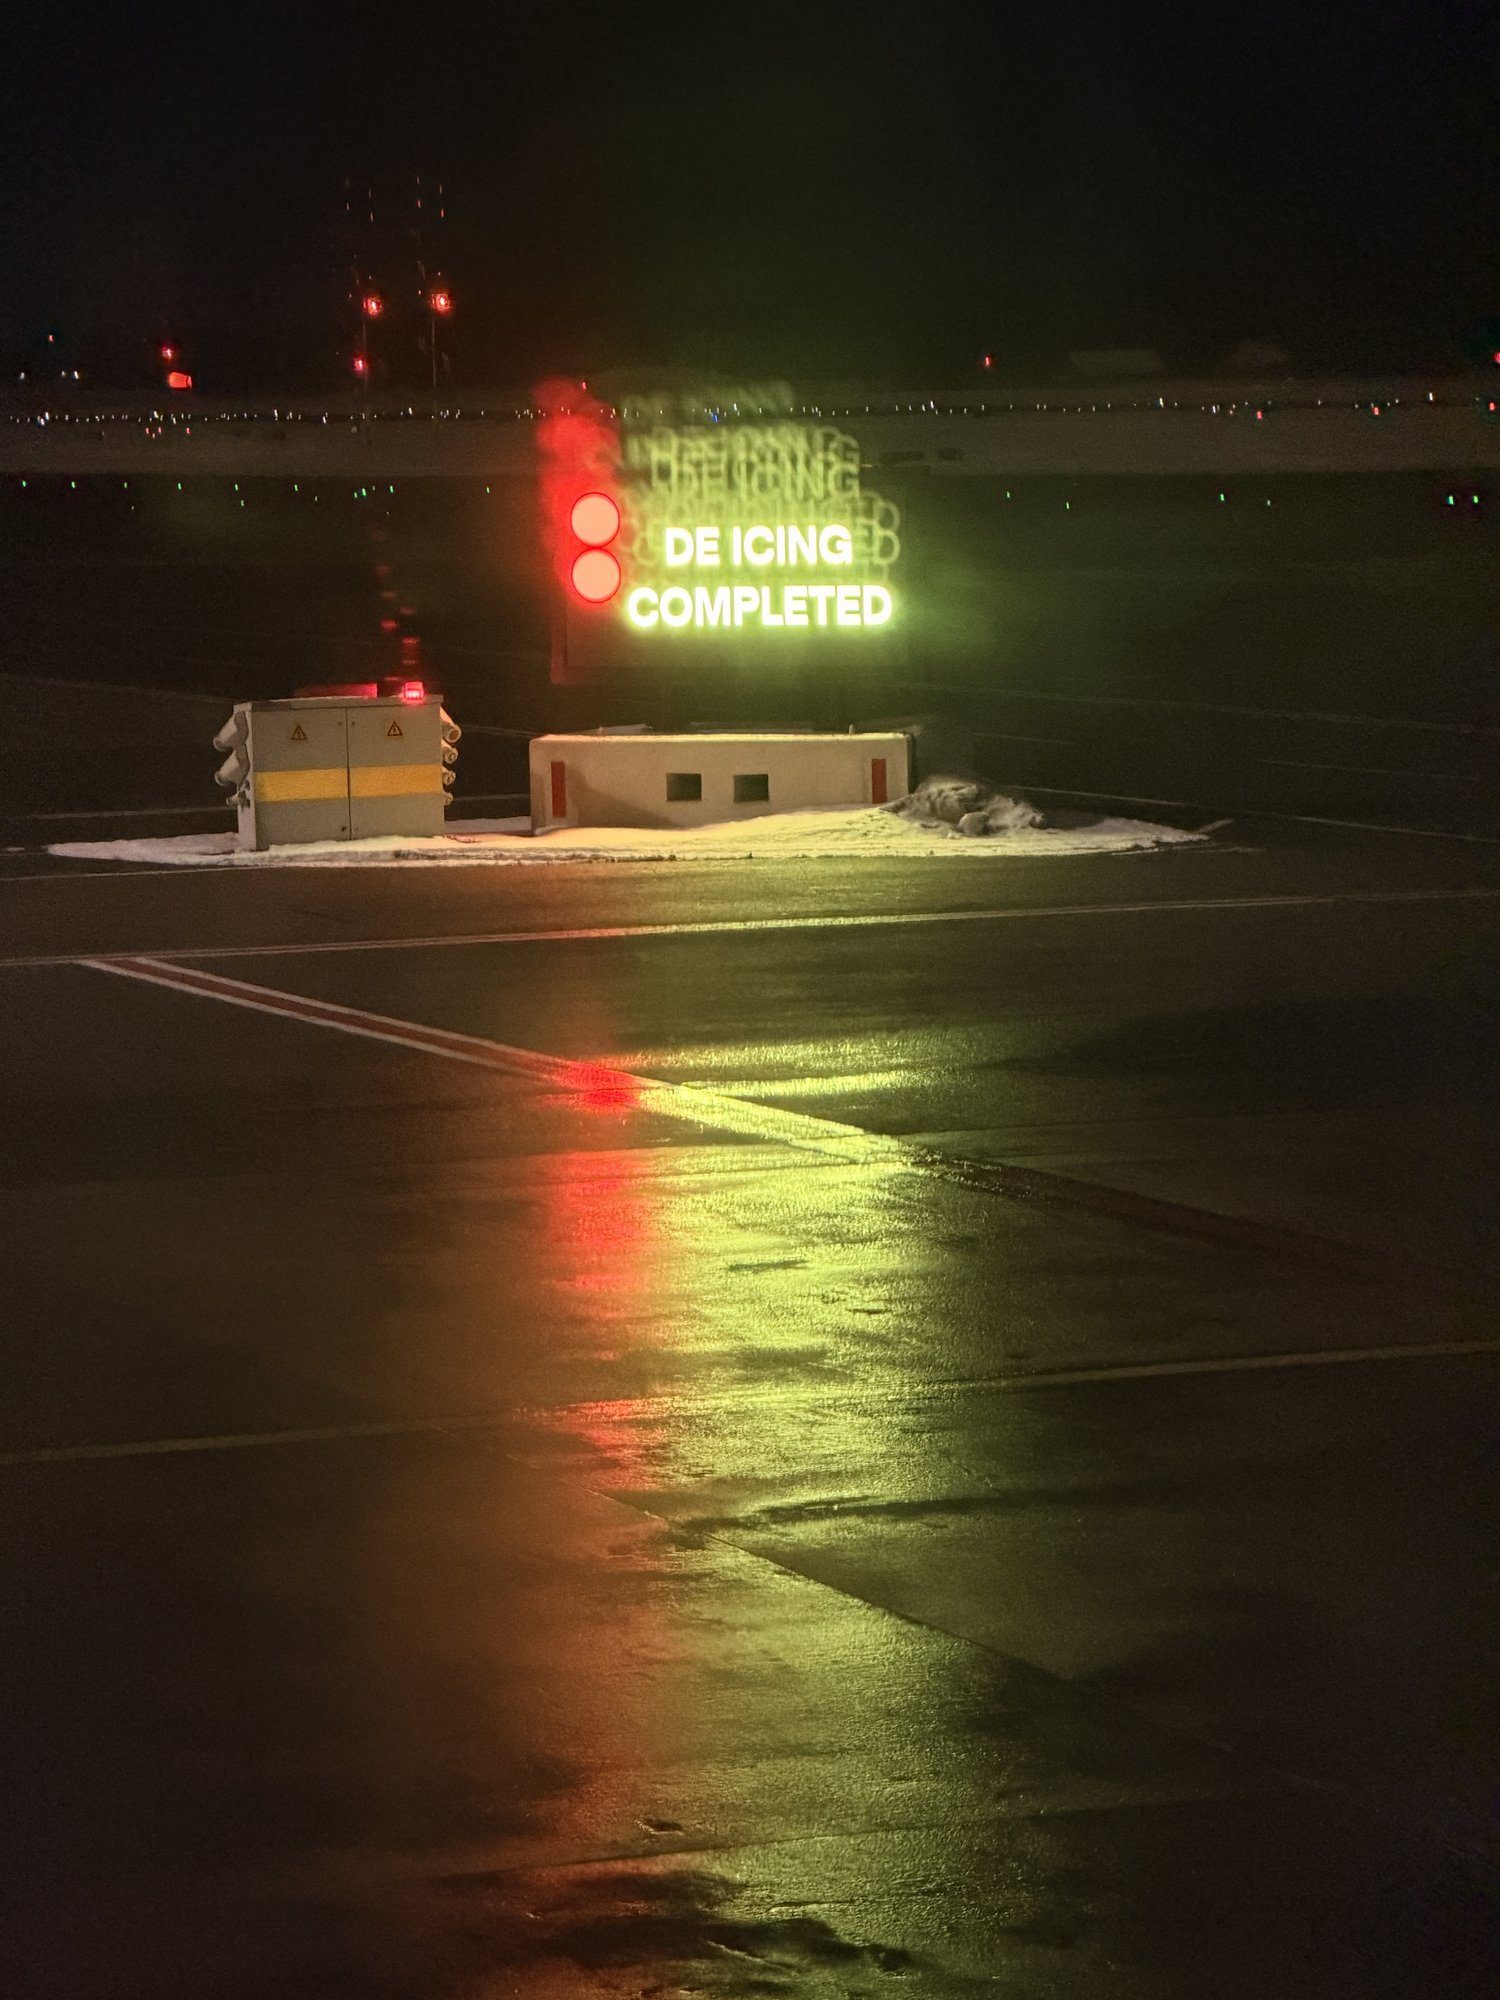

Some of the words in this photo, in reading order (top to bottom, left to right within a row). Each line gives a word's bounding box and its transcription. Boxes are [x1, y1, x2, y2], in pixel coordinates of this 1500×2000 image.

[665, 526, 720, 566] DE
[732, 524, 852, 566] ICING
[627, 585, 892, 627] COMPLETED
